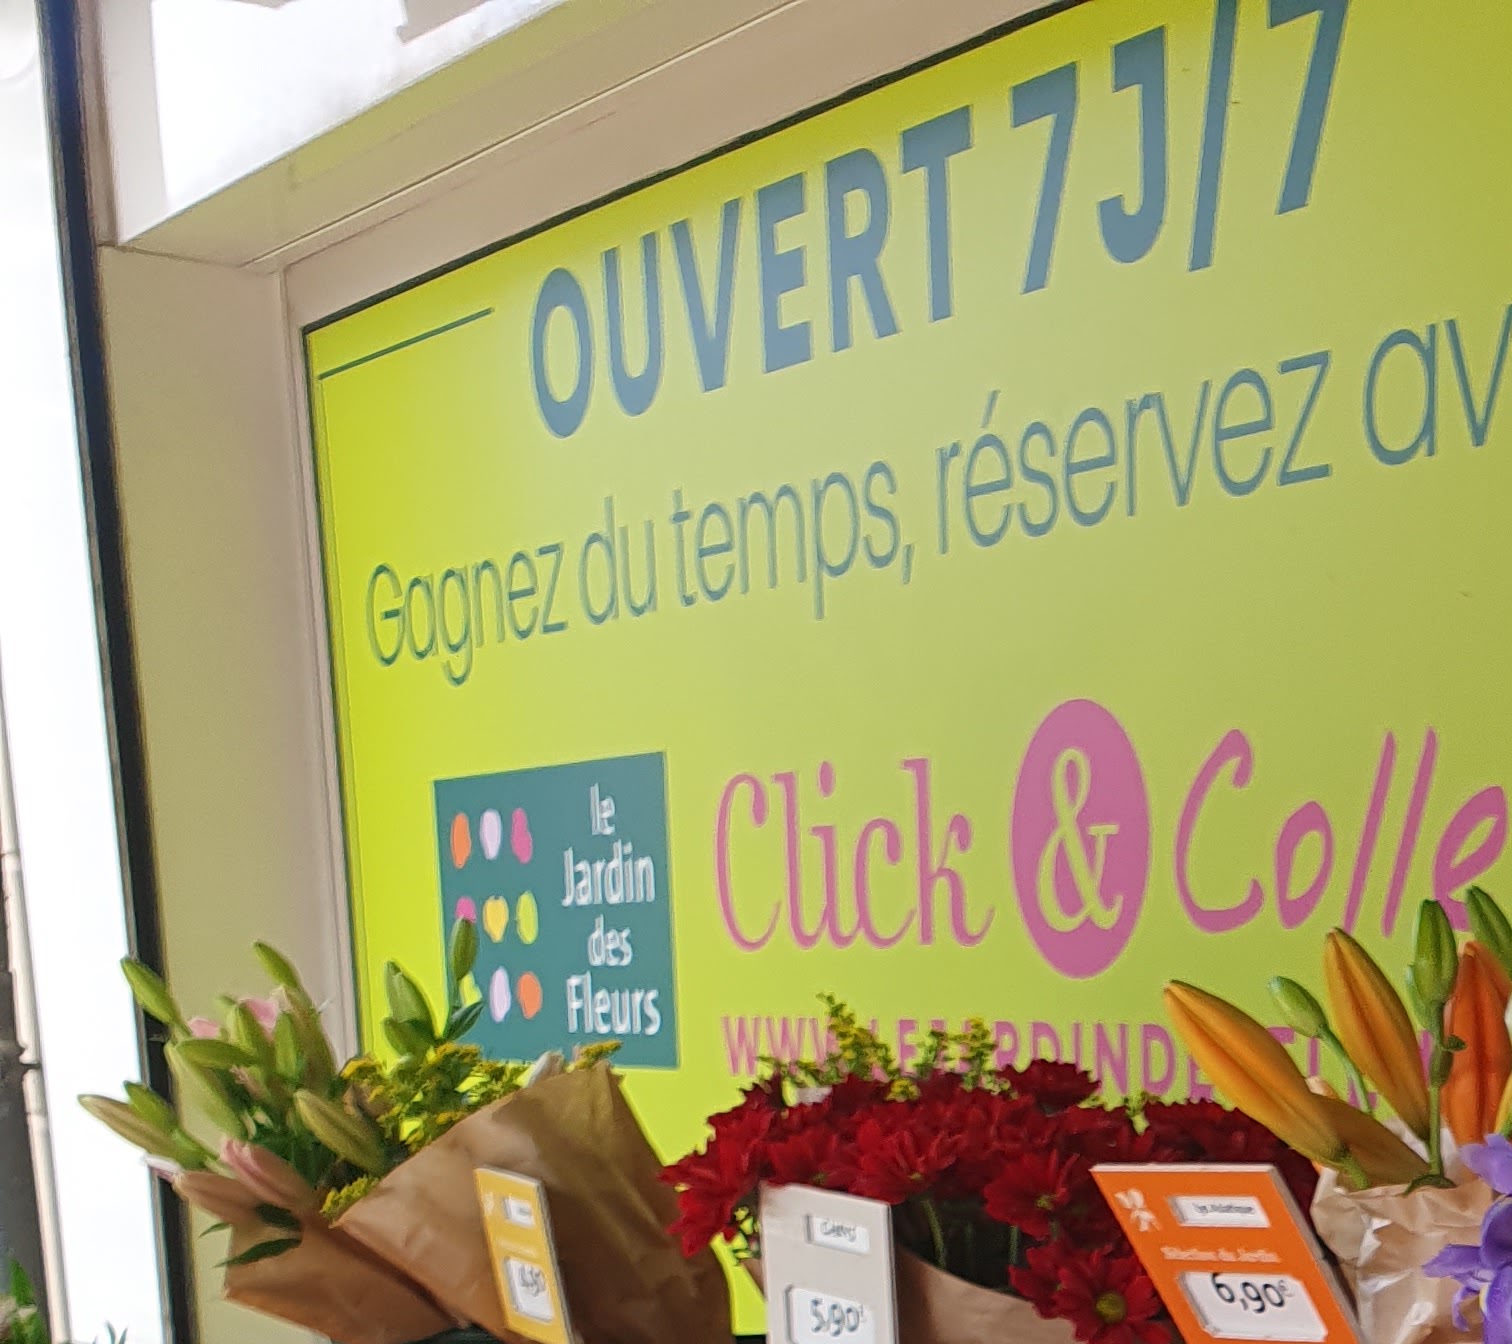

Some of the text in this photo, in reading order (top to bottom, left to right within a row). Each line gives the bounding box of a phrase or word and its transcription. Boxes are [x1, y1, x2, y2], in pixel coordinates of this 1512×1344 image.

[529, 0, 1350, 439] OUVERT 7J/7
[366, 542, 569, 687] Gagnez
[578, 494, 659, 625] du
[669, 459, 914, 622] temps,
[936, 348, 1334, 555] réservez
[589, 782, 616, 836] le
[561, 838, 656, 908] Jardin
[715, 757, 996, 953] Click
[1037, 748, 1125, 933] &
[586, 913, 634, 967] des
[565, 970, 662, 1037] Fleurs
